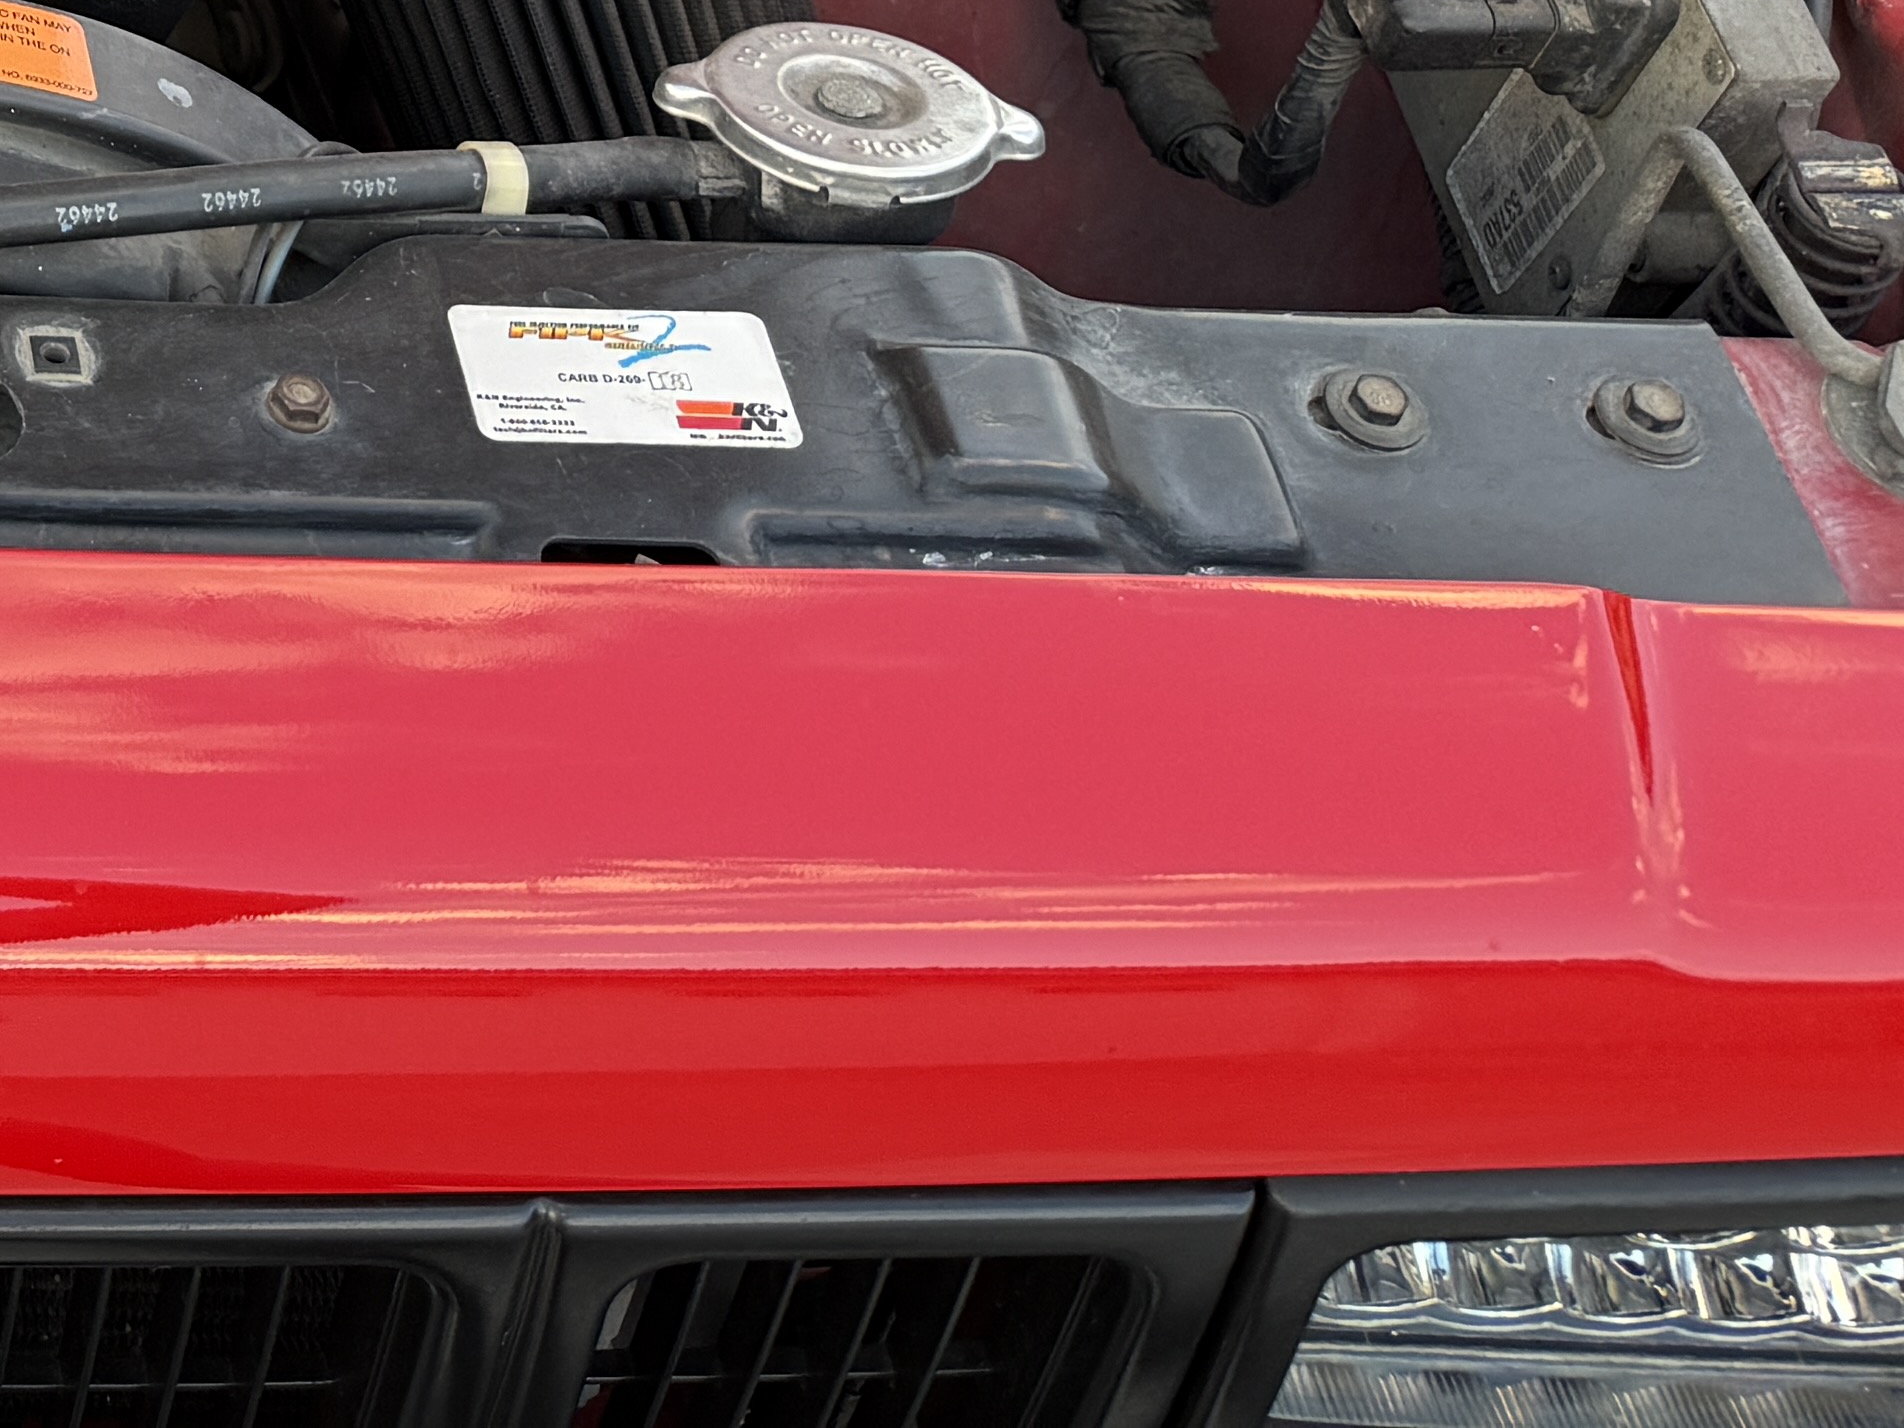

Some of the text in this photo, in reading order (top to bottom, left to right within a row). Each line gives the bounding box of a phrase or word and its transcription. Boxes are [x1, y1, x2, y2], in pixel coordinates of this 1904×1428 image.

[11, 11, 41, 25] FAN
[42, 18, 72, 33] MAY
[0, 32, 14, 42] IN
[17, 35, 47, 50] THE
[49, 43, 72, 57] ON
[734, 29, 967, 91] DO NOT OPEN HOT
[754, 103, 953, 158] OPEN SLOWLY
[201, 187, 260, 211] 24462
[54, 201, 117, 228] 24462
[557, 372, 598, 382] CARB
